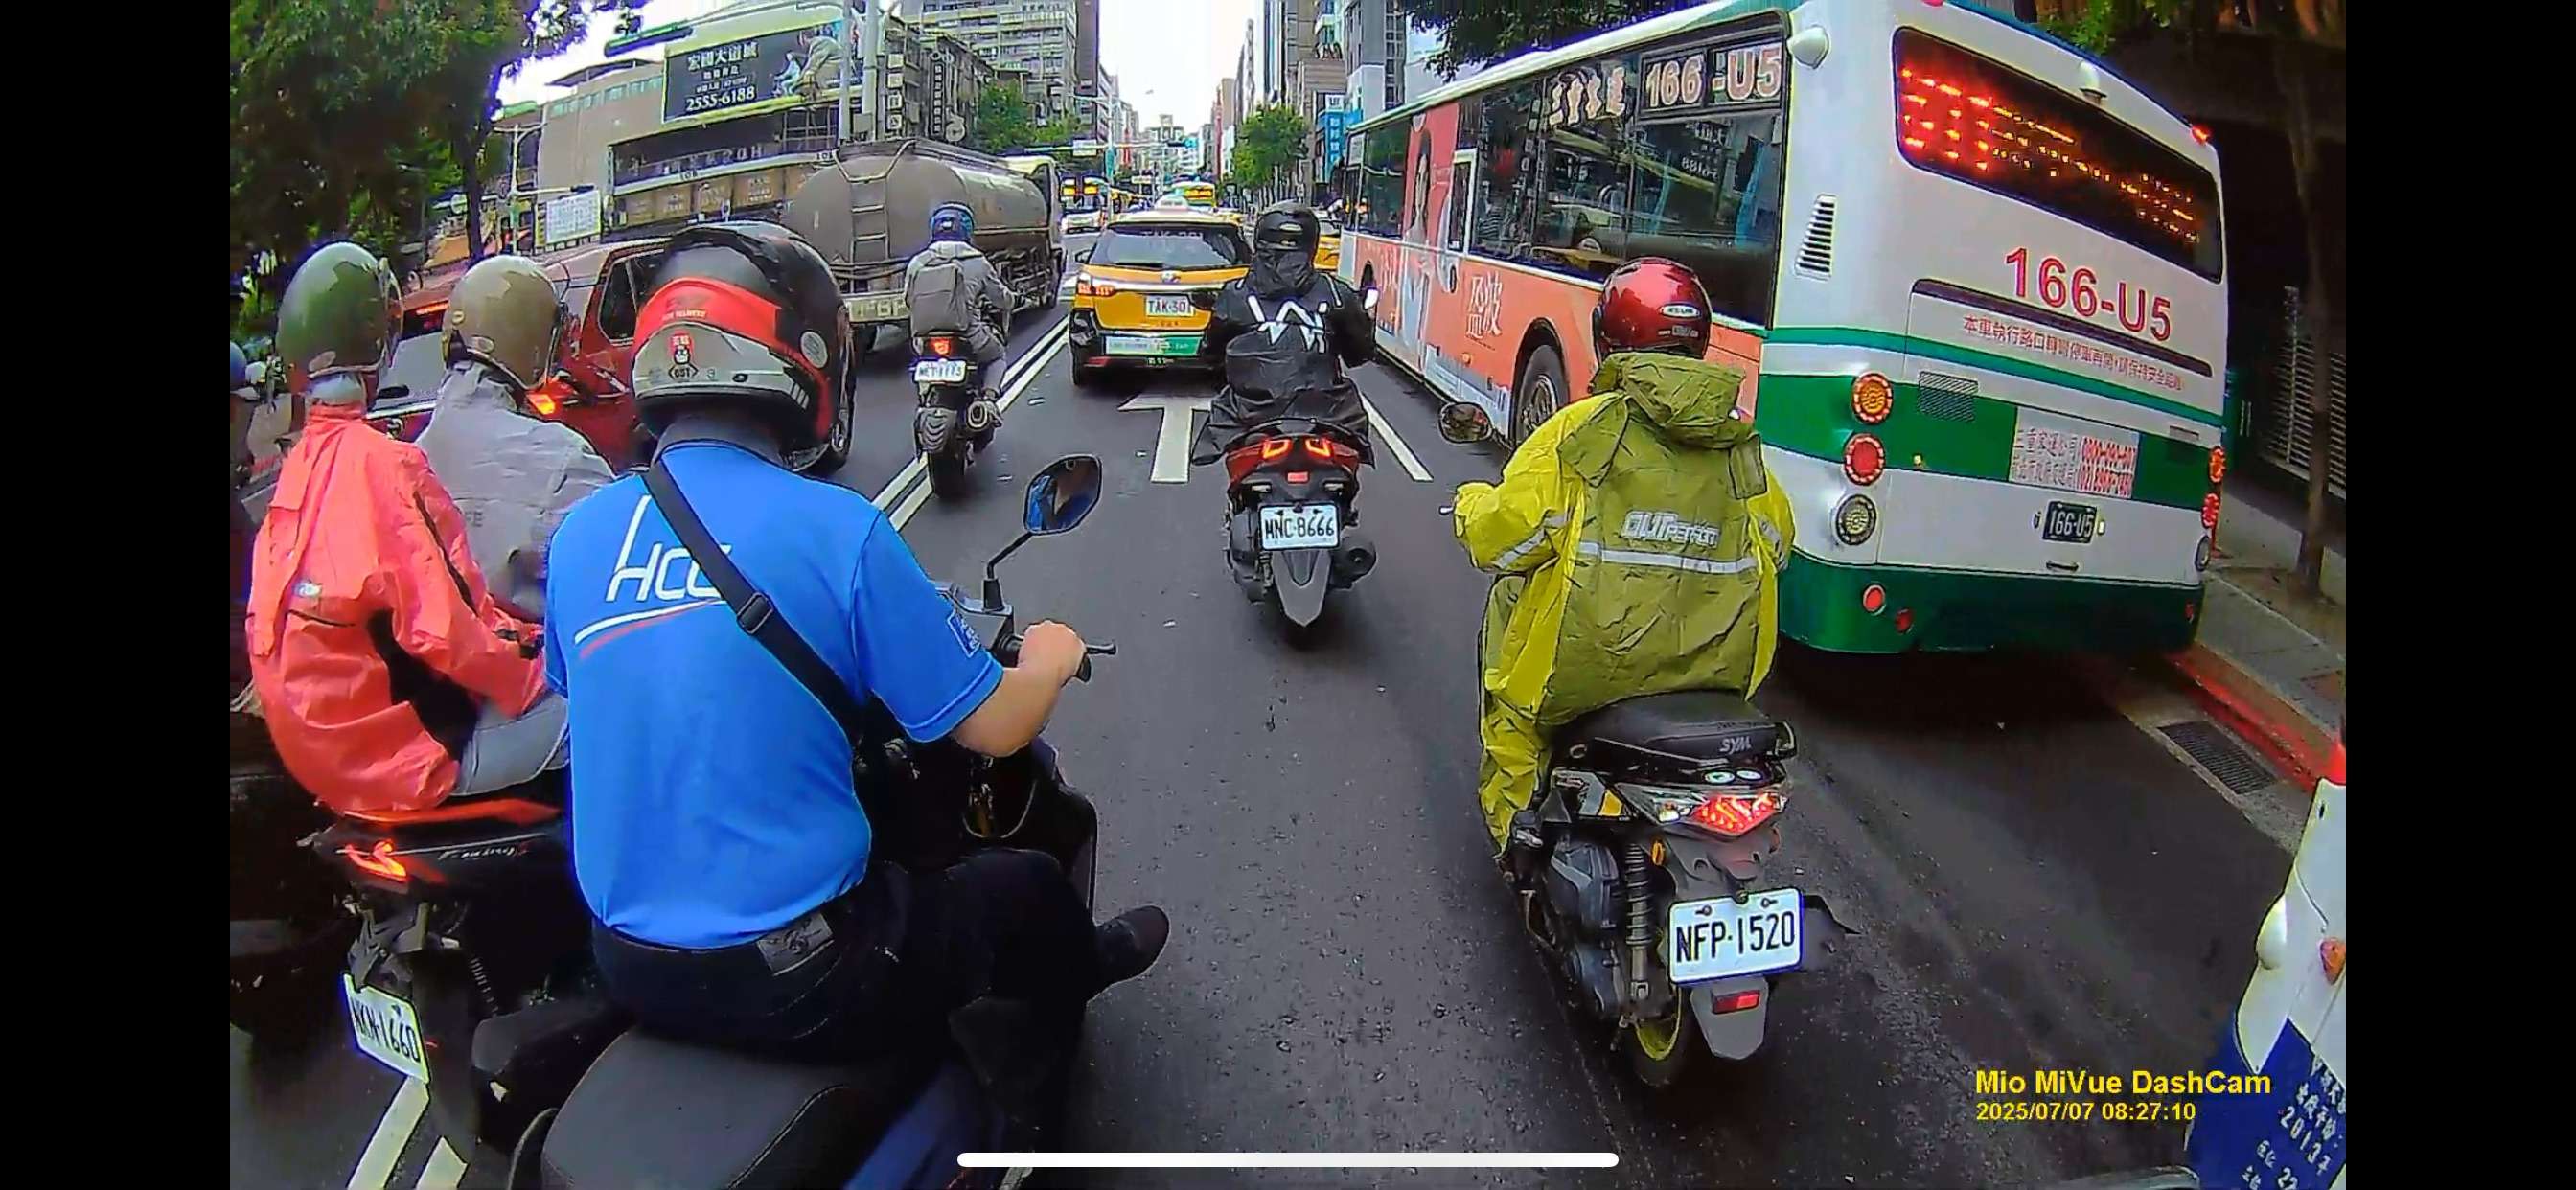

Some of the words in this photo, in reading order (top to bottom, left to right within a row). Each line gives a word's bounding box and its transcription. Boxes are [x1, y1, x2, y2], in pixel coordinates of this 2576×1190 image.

[685, 85, 756, 112] 2555-6188
[2006, 247, 2171, 341] 166-U5
[1264, 516, 1335, 539] MNC-8666
[2049, 509, 2094, 538] 166-U5
[1719, 736, 1752, 755] SYM
[1676, 910, 1795, 963] NFP-1520
